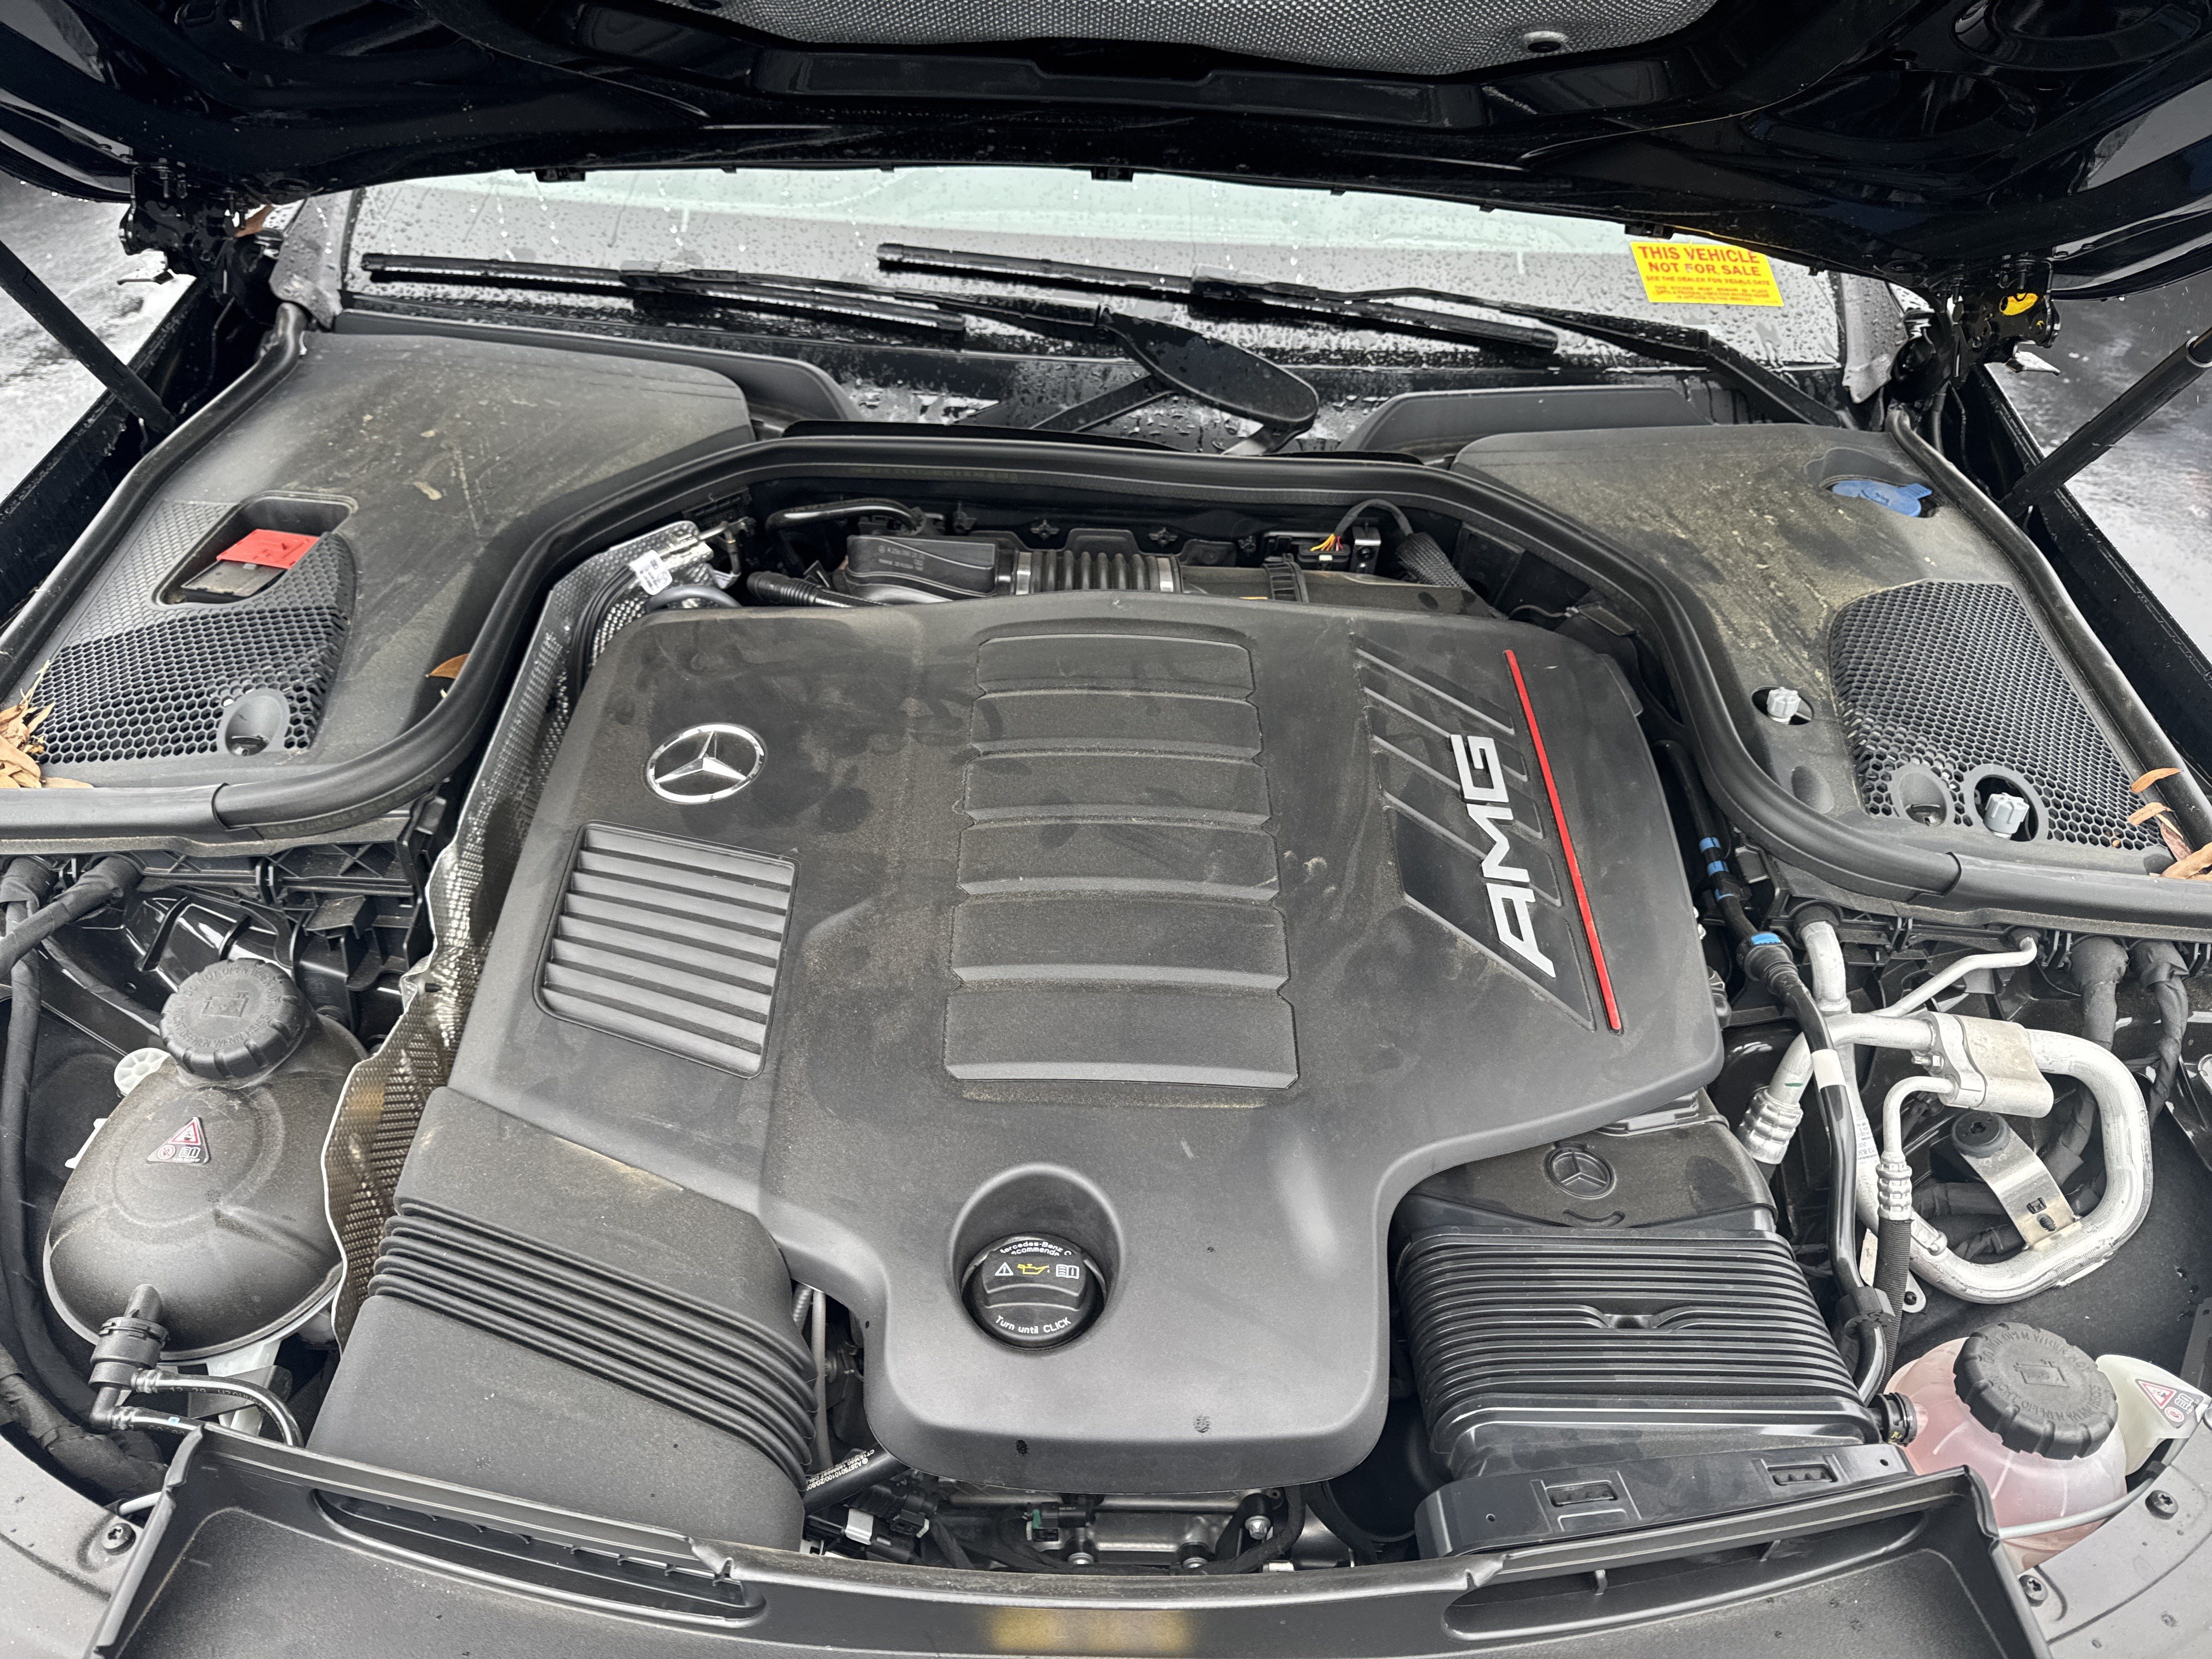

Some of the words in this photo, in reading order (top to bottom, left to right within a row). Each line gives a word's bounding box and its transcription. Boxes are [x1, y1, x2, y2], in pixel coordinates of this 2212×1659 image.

[1637, 245, 1680, 259] THIS
[1683, 247, 1760, 264] VEHICLE
[1647, 261, 1680, 273] NOT
[1684, 263, 1717, 275] FOR
[1721, 264, 1762, 276] SALE
[1450, 734, 1556, 979] AMG
[996, 1315, 1015, 1331] Turn
[1018, 1325, 1039, 1334] until
[1043, 1317, 1072, 1334] CLICK
